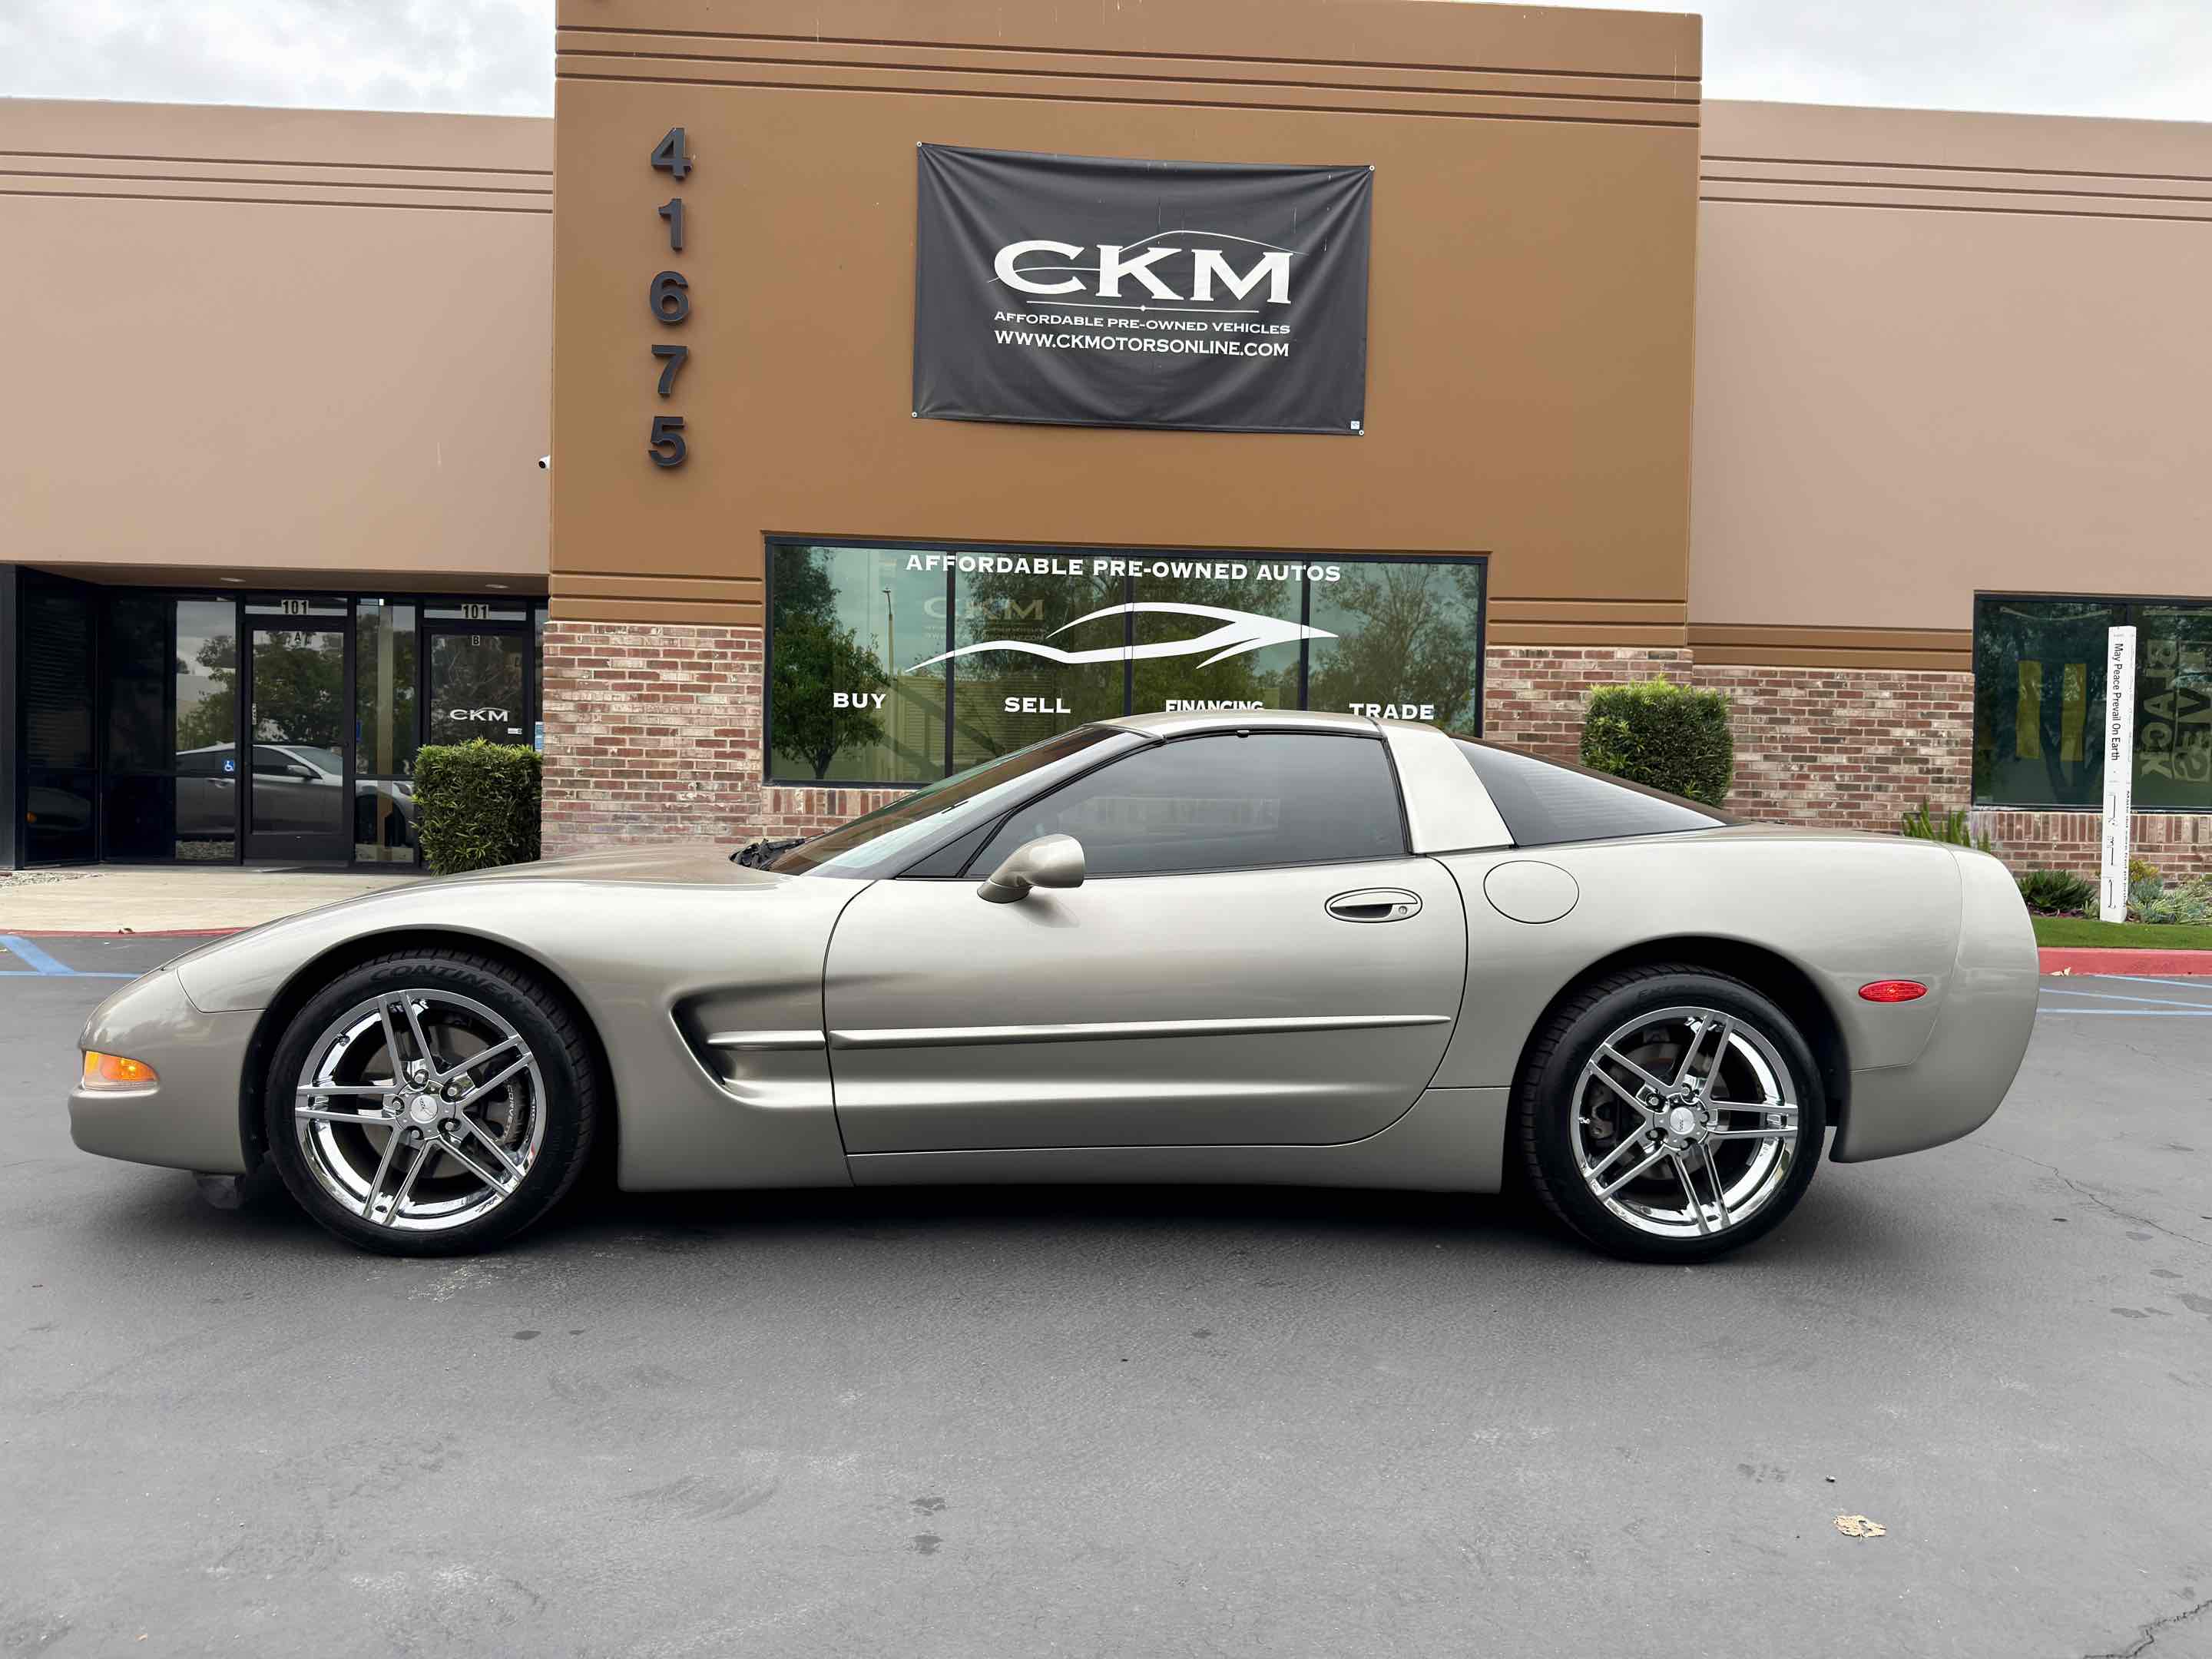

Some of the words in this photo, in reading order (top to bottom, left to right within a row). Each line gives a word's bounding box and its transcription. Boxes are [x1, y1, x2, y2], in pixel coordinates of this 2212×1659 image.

[994, 240, 1294, 305] CKM
[648, 127, 693, 467] 41675
[994, 311, 1104, 328] AFFORDABLE
[1107, 318, 1208, 332] PRE-OWNED
[1211, 322, 1290, 335] VEHICLES
[994, 329, 1290, 357] WWW.CKMOTORSONLINE.COM
[905, 554, 1084, 576] AFFORDABLE
[1093, 560, 1249, 581] PRE-OWNED
[1256, 565, 1341, 582] AUTOS
[282, 600, 308, 614] 101
[462, 604, 488, 620] 101
[473, 635, 480, 645] B
[2113, 643, 2124, 662] May
[2113, 664, 2123, 690] Peace
[833, 692, 887, 710] BUY
[1004, 697, 1071, 714] SELL
[2112, 692, 2122, 720] Prevail
[449, 708, 508, 722] CKM
[1349, 703, 1434, 720] TRADE
[2111, 723, 2121, 735] On
[2111, 737, 2121, 760] Earth
